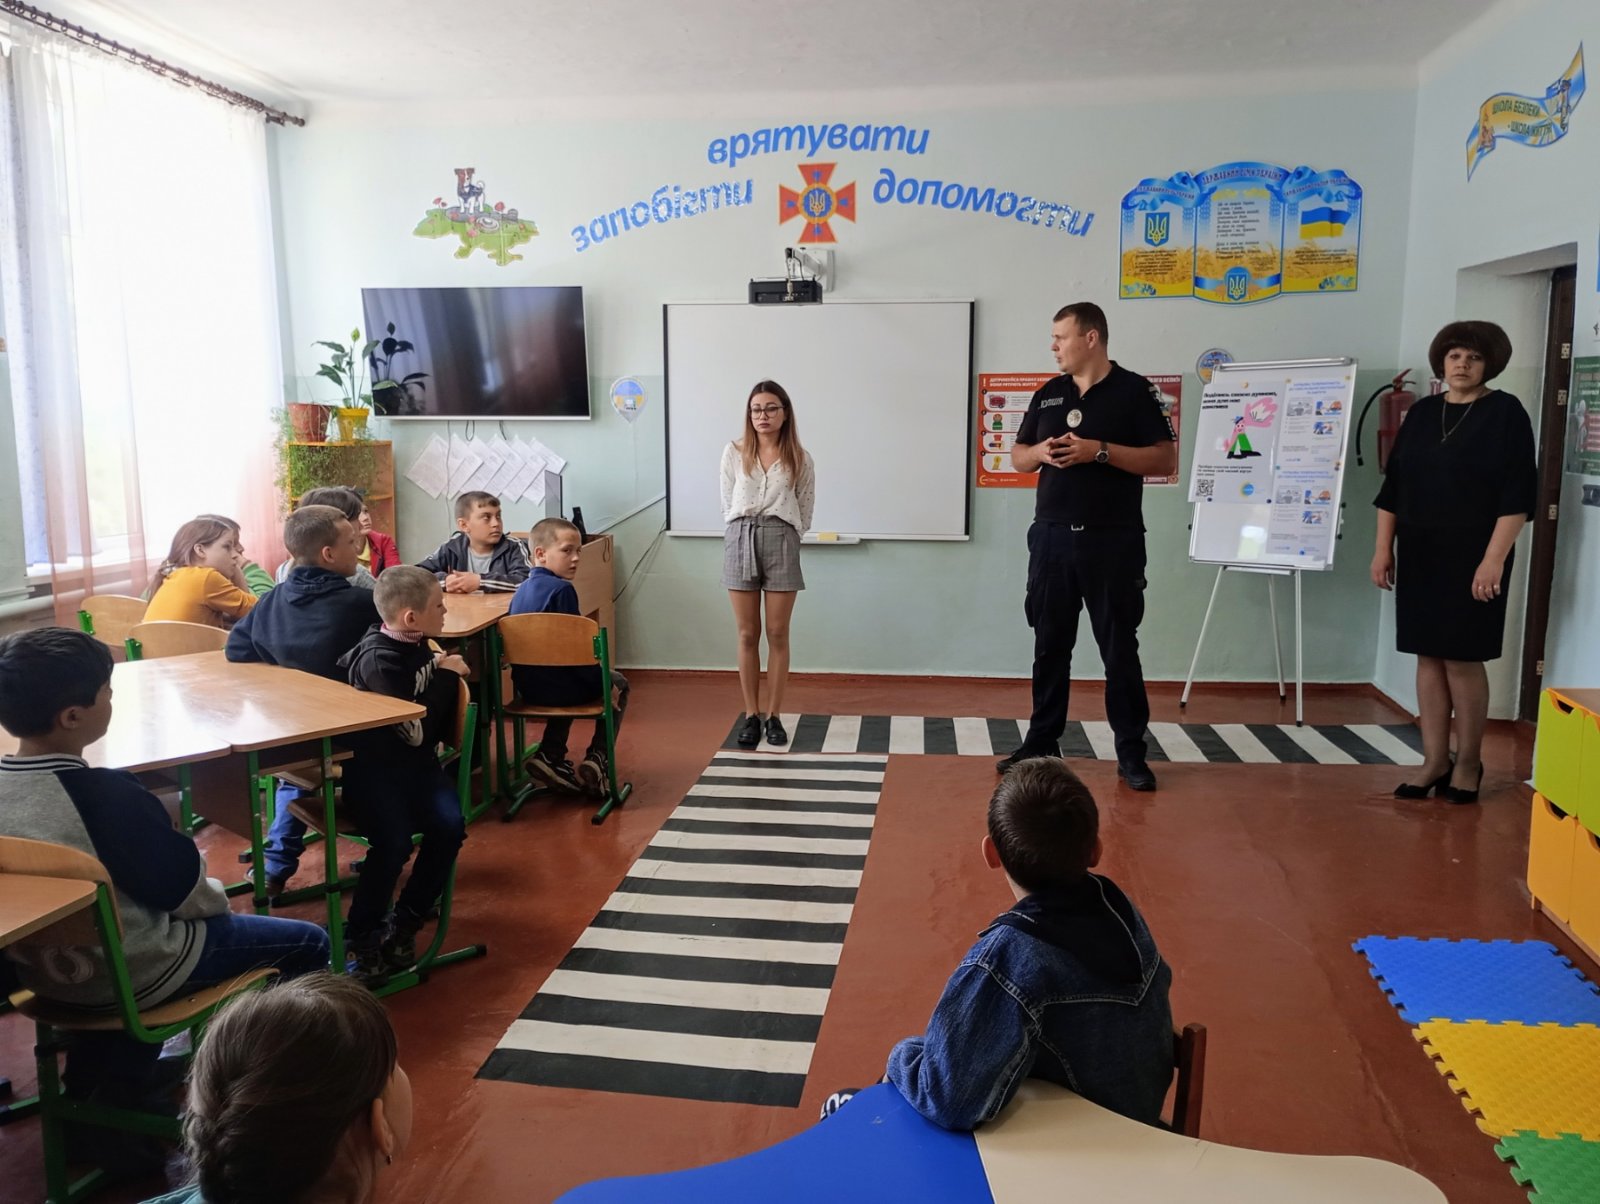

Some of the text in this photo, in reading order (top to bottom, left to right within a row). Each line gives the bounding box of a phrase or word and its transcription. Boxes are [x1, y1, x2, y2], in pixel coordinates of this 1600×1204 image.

[707, 123, 931, 168] врятувати
[570, 178, 754, 252] запобігти
[872, 168, 1095, 237] допомогти
